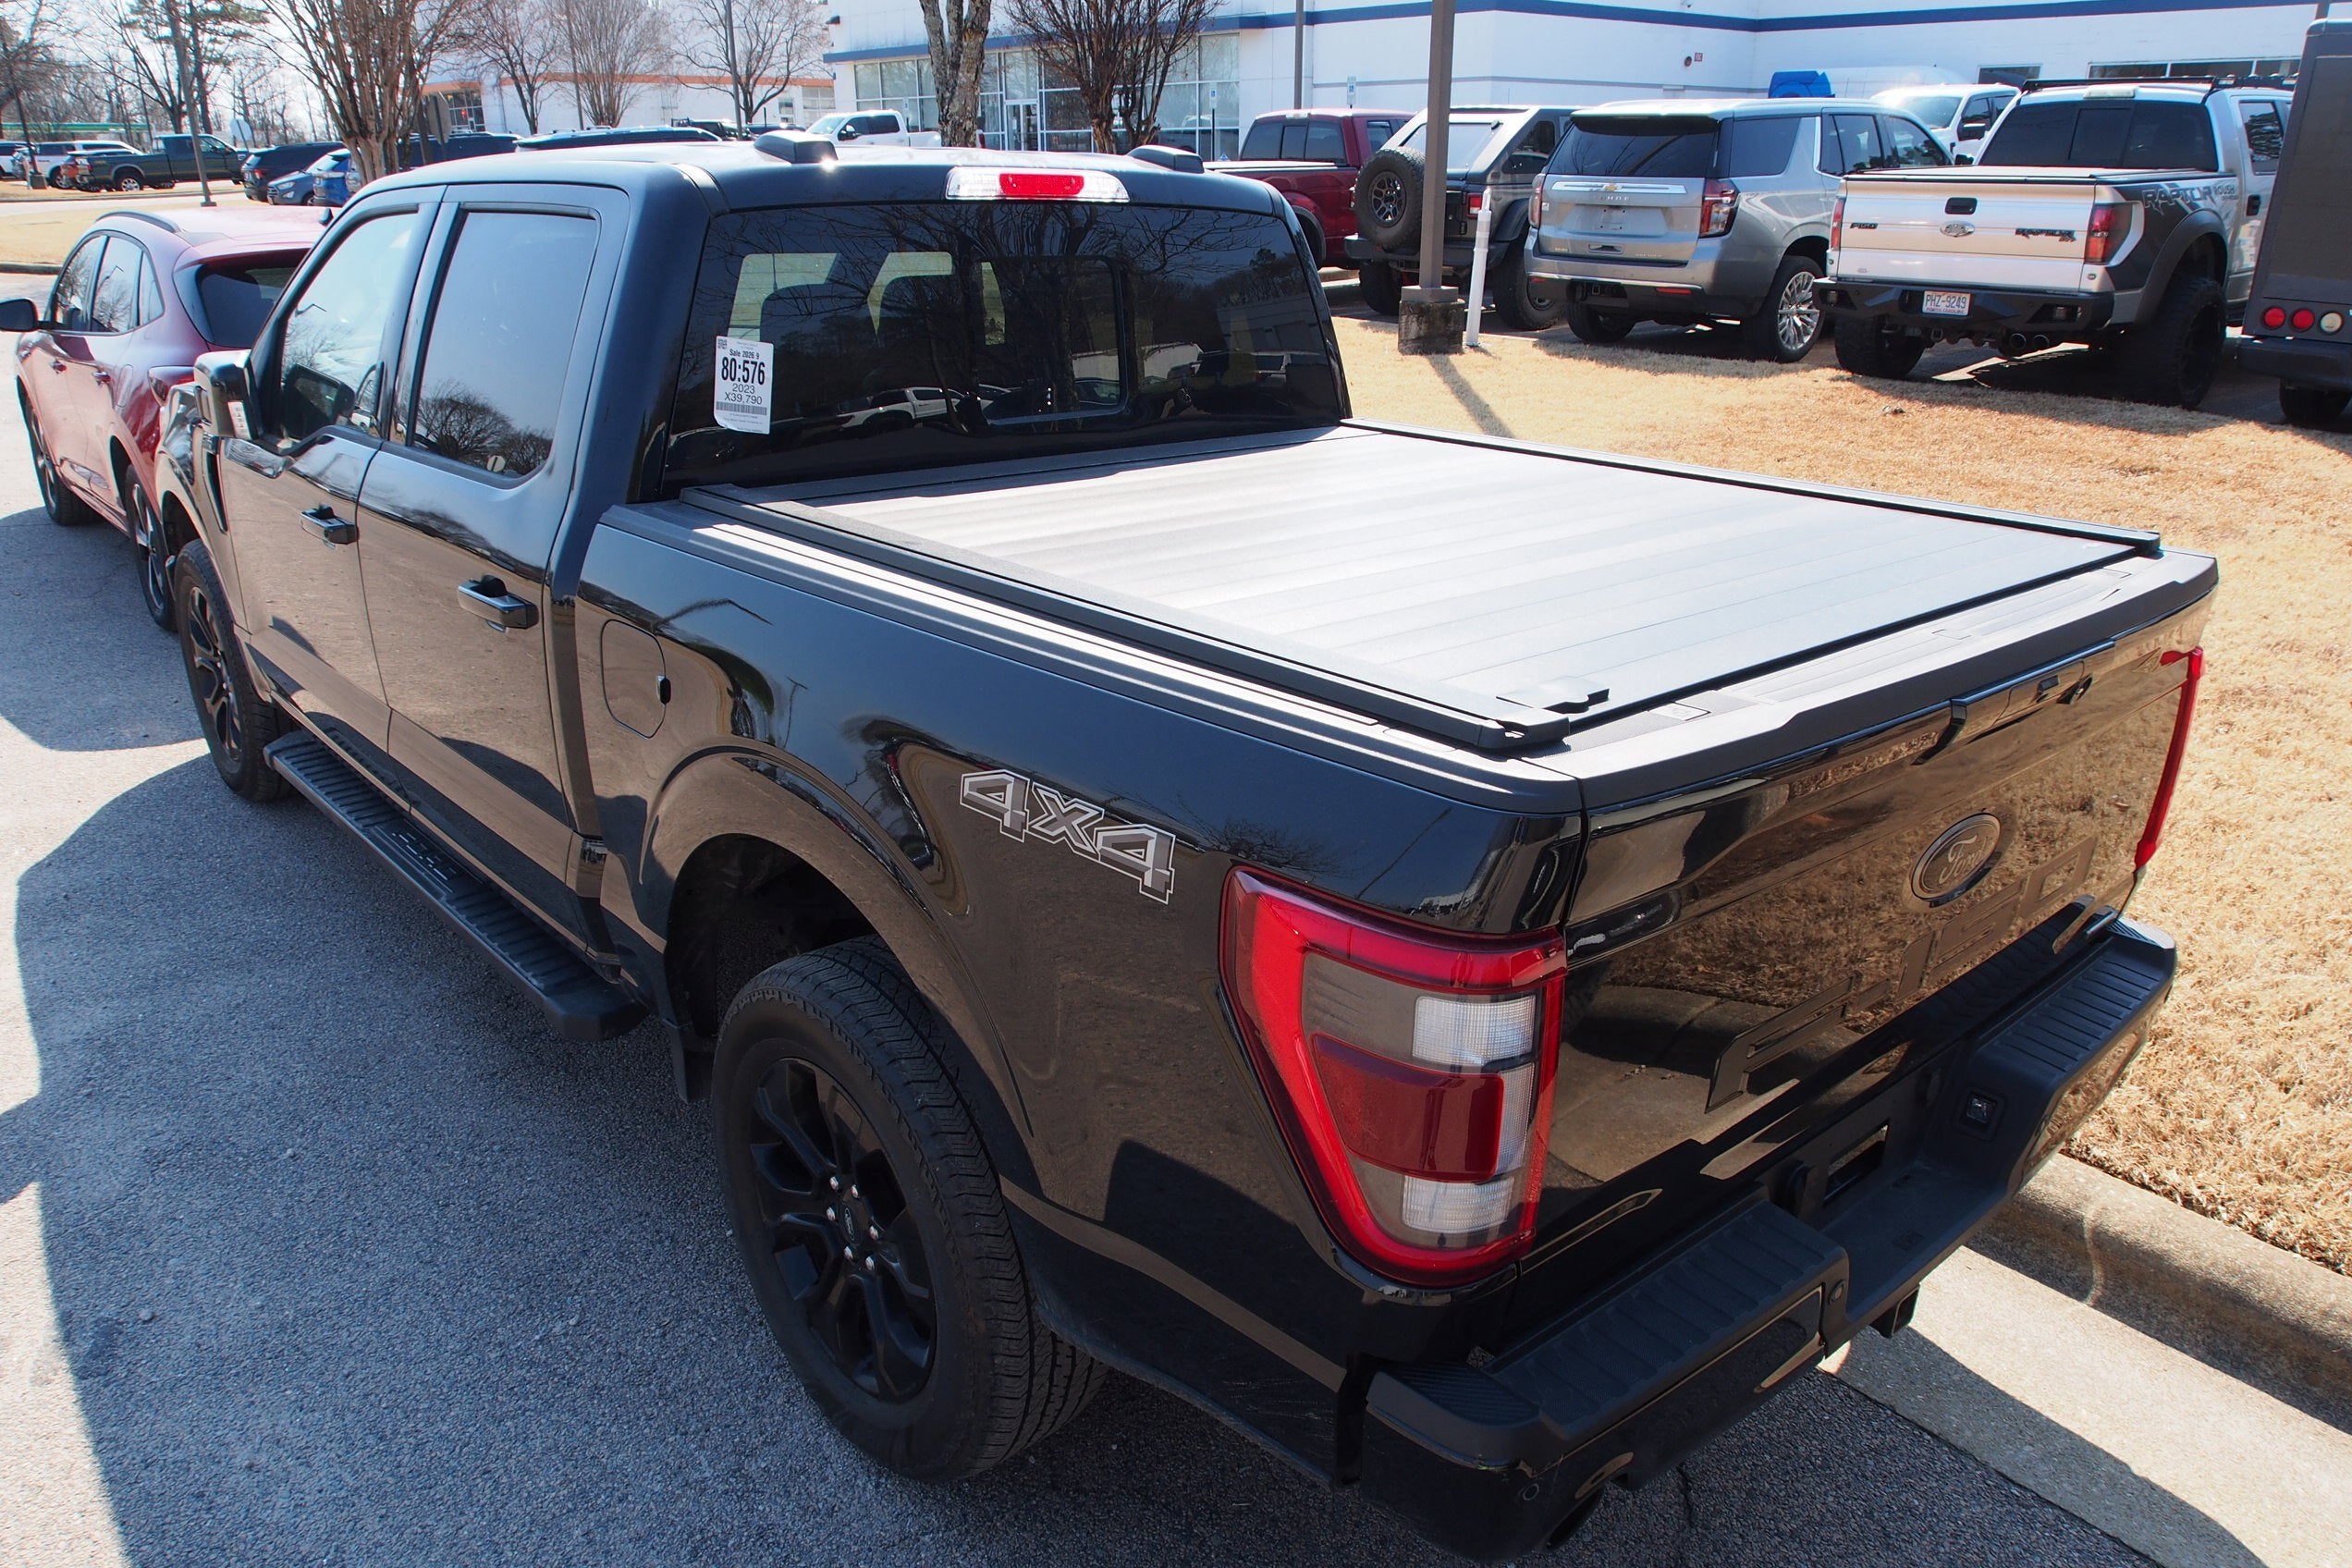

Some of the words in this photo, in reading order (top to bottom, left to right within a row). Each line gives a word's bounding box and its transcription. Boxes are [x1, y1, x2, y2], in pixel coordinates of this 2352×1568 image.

[2141, 186, 2215, 215] RAPTOR
[1925, 294, 1967, 309] PHZ-9249
[729, 349, 741, 357] Sale
[742, 350, 754, 359] 2026
[721, 357, 766, 386] 80:576
[732, 383, 755, 394] 2023
[1938, 833, 1989, 885] Ford
